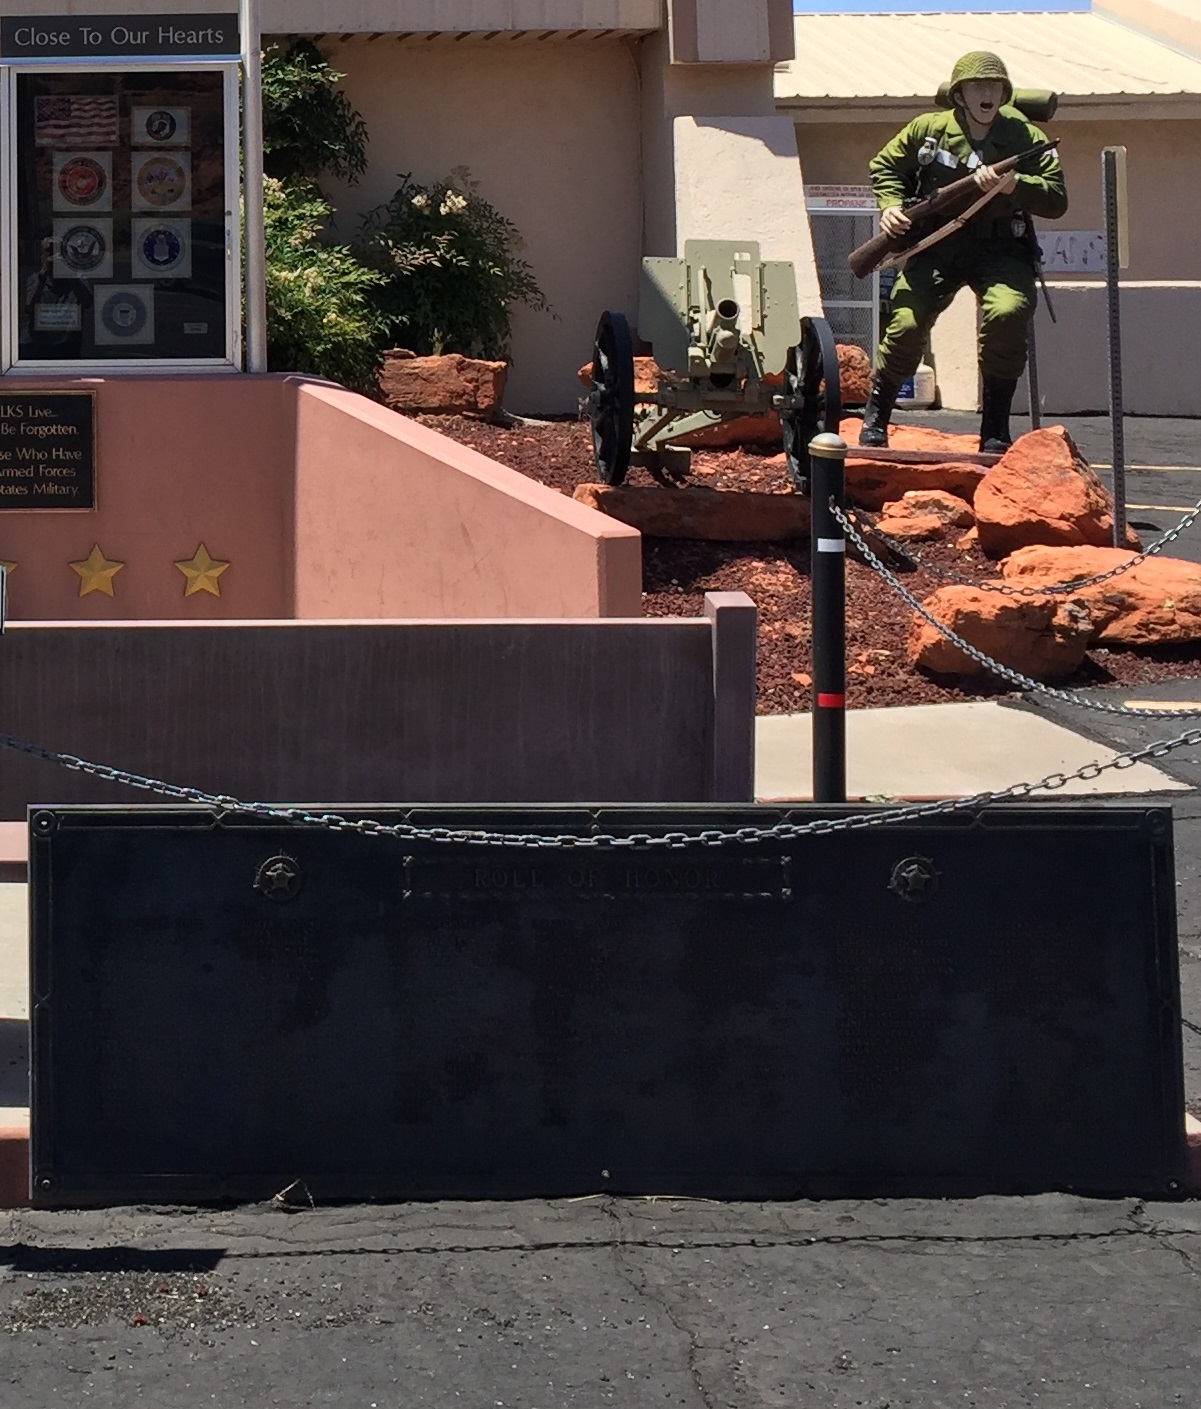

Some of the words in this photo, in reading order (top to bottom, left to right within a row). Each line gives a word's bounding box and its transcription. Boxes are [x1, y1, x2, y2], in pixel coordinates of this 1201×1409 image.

[14, 27, 70, 47] Close
[78, 27, 103, 45] To
[110, 26, 149, 45] Our
[157, 26, 224, 44] Hearts
[826, 199, 867, 207] PROPANE
[1, 423, 16, 435] Be
[16, 448, 48, 460] Who
[52, 447, 82, 460] Have
[39, 465, 76, 477] Forces
[473, 868, 544, 889] ROLL
[624, 868, 721, 889] HONOR
